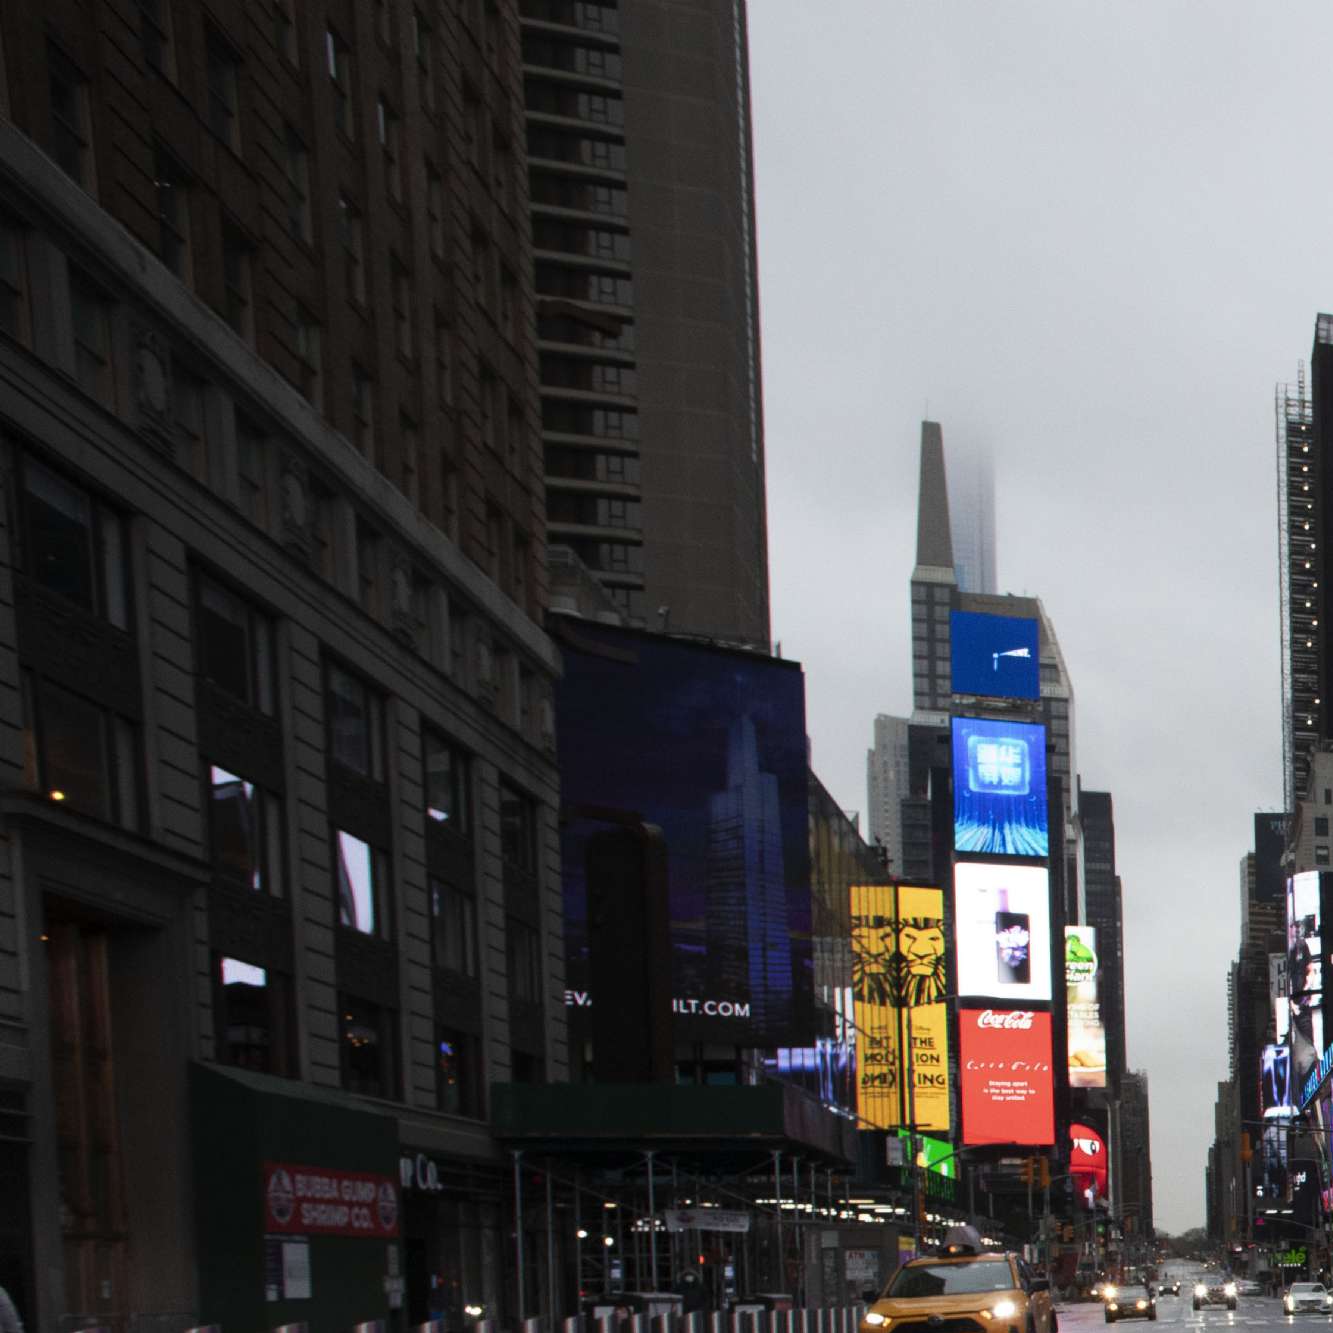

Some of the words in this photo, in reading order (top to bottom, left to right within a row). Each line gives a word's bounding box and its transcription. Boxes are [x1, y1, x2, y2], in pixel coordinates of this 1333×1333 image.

[912, 1036, 935, 1047] THE
[914, 1053, 940, 1063] ION
[912, 1070, 946, 1087] ING
[294, 1173, 338, 1199] BUBBA
[340, 1179, 377, 1203] GUMP
[301, 1203, 350, 1228] SHRIMP
